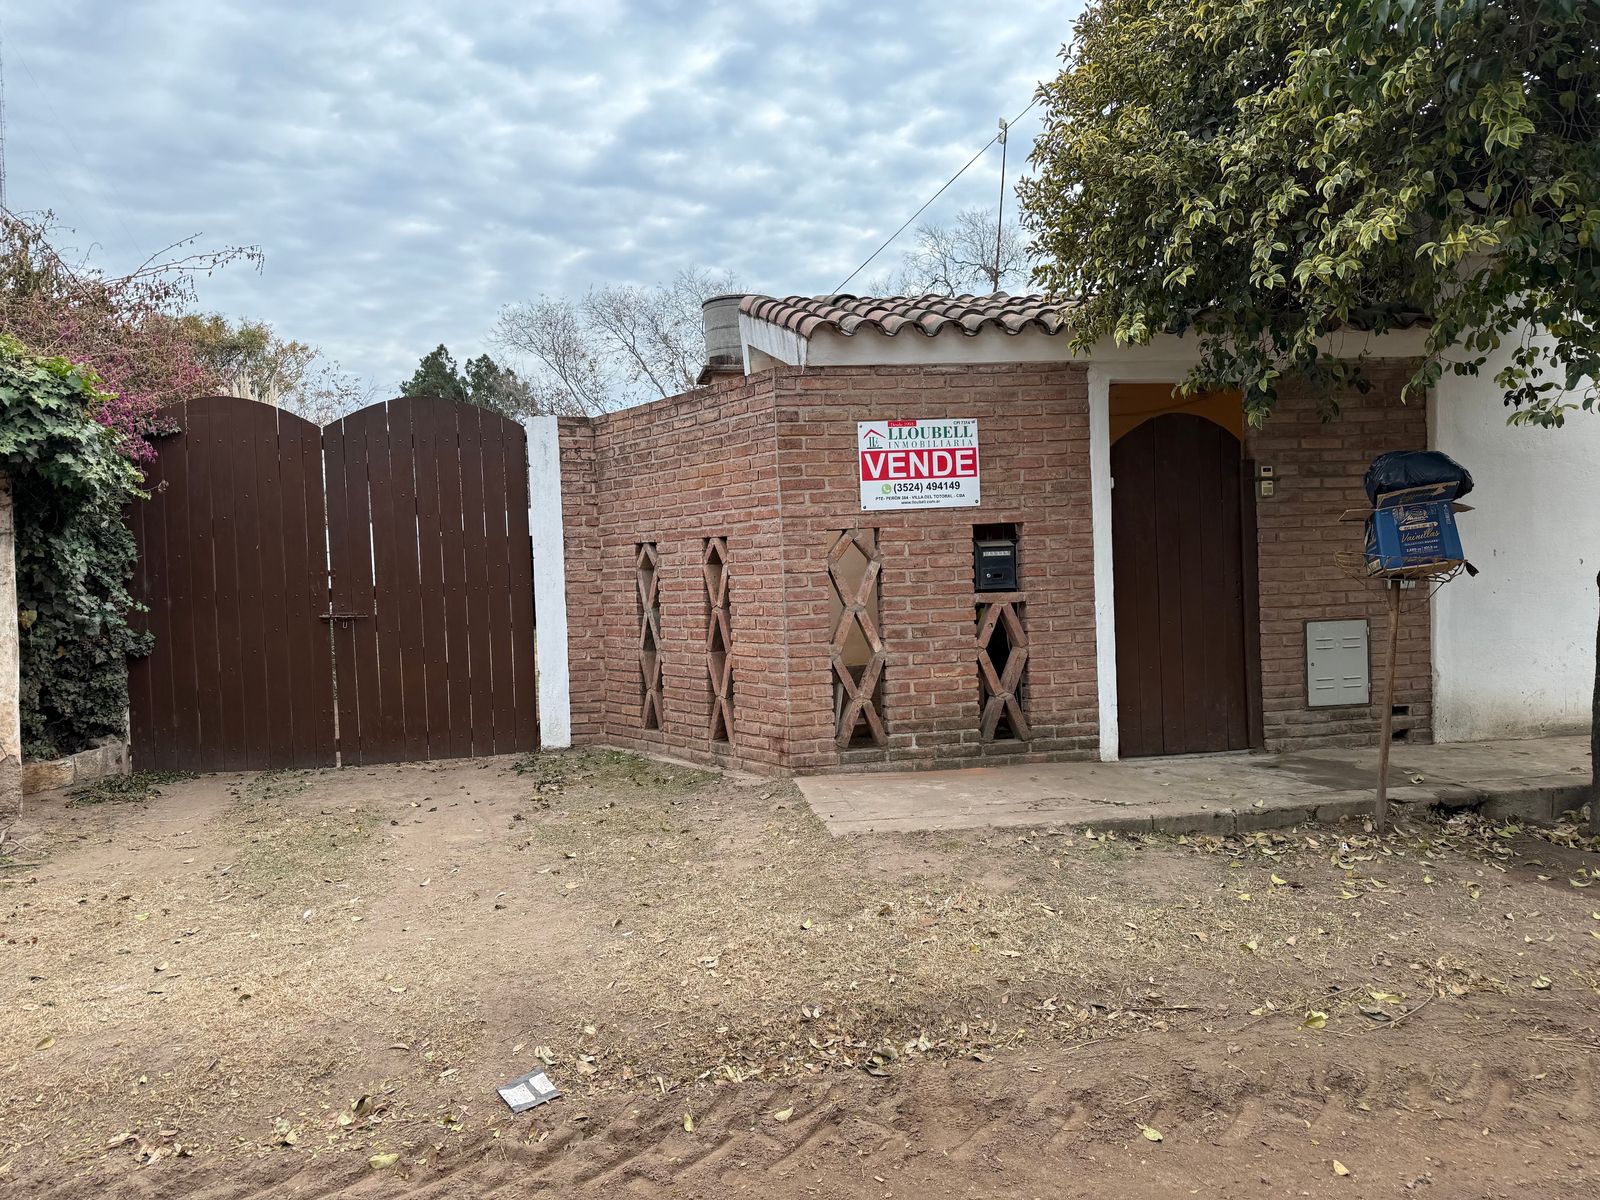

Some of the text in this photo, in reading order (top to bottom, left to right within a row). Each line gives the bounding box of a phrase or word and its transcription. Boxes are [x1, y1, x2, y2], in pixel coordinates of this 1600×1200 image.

[888, 426, 972, 440] LLOUBELL
[888, 439, 973, 449] INMOBILIARIA
[864, 450, 974, 478] VENDE
[894, 481, 960, 494] (3524) 494149
[1401, 528, 1440, 543] Vainillas
